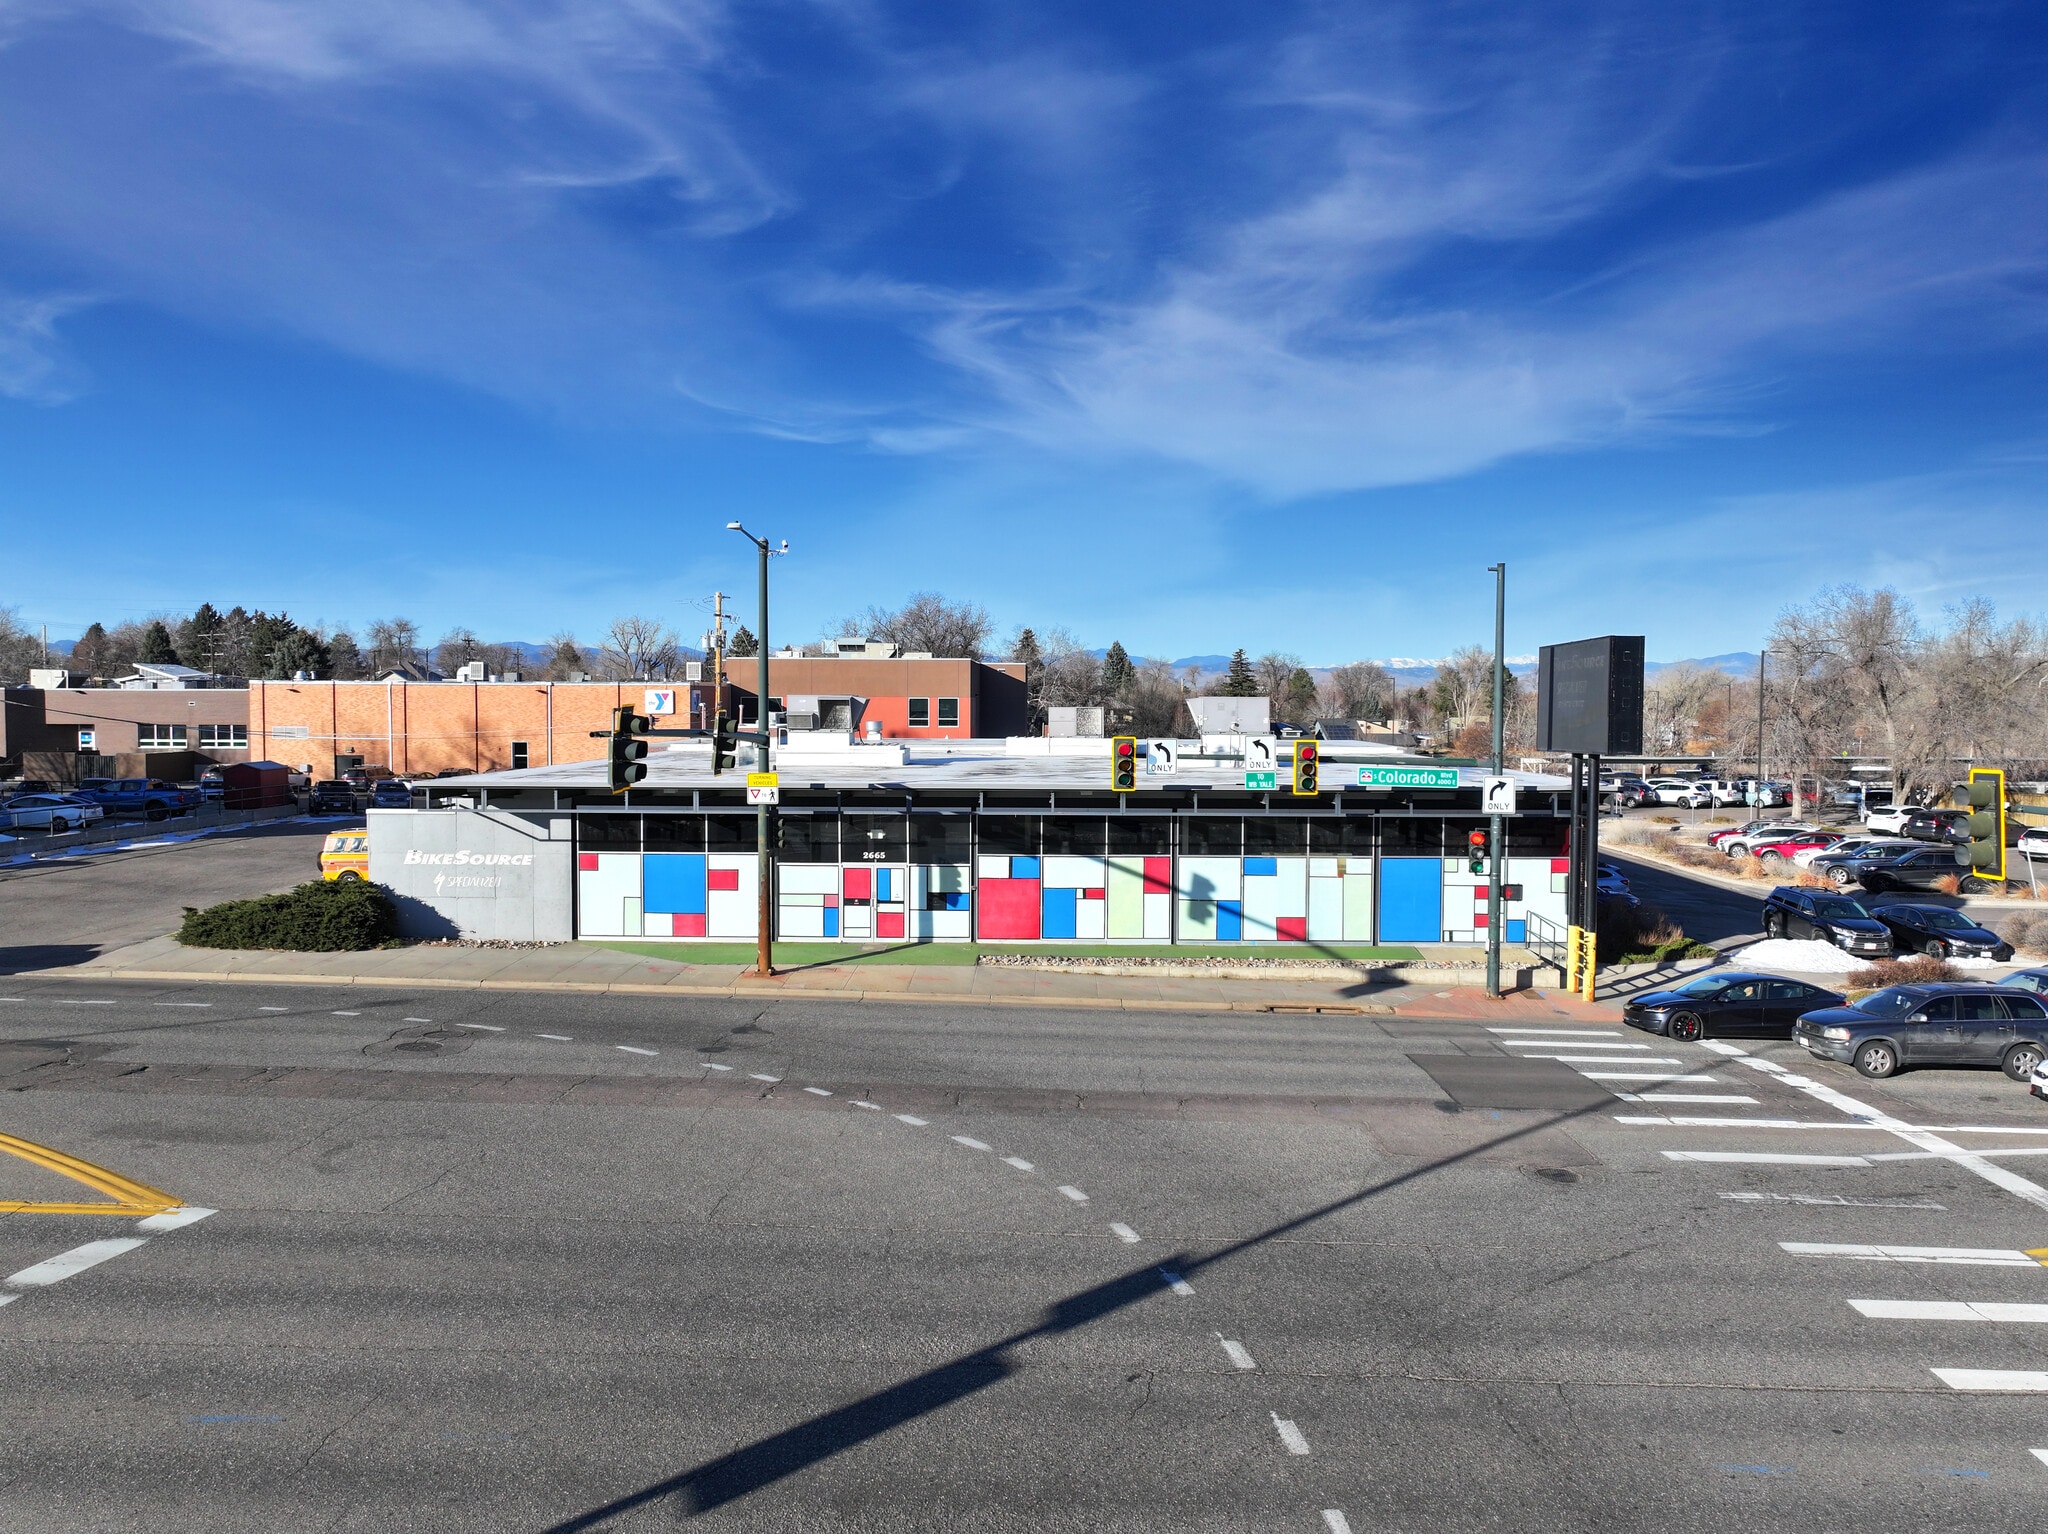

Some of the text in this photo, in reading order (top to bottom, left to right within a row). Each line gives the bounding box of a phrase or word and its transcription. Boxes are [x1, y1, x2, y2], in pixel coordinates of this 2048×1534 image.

[1151, 764, 1172, 772] ONLY
[1249, 761, 1271, 769] ONLY
[1378, 770, 1436, 784] Colorado
[1487, 802, 1510, 811] ONLY
[863, 851, 886, 859] 2665
